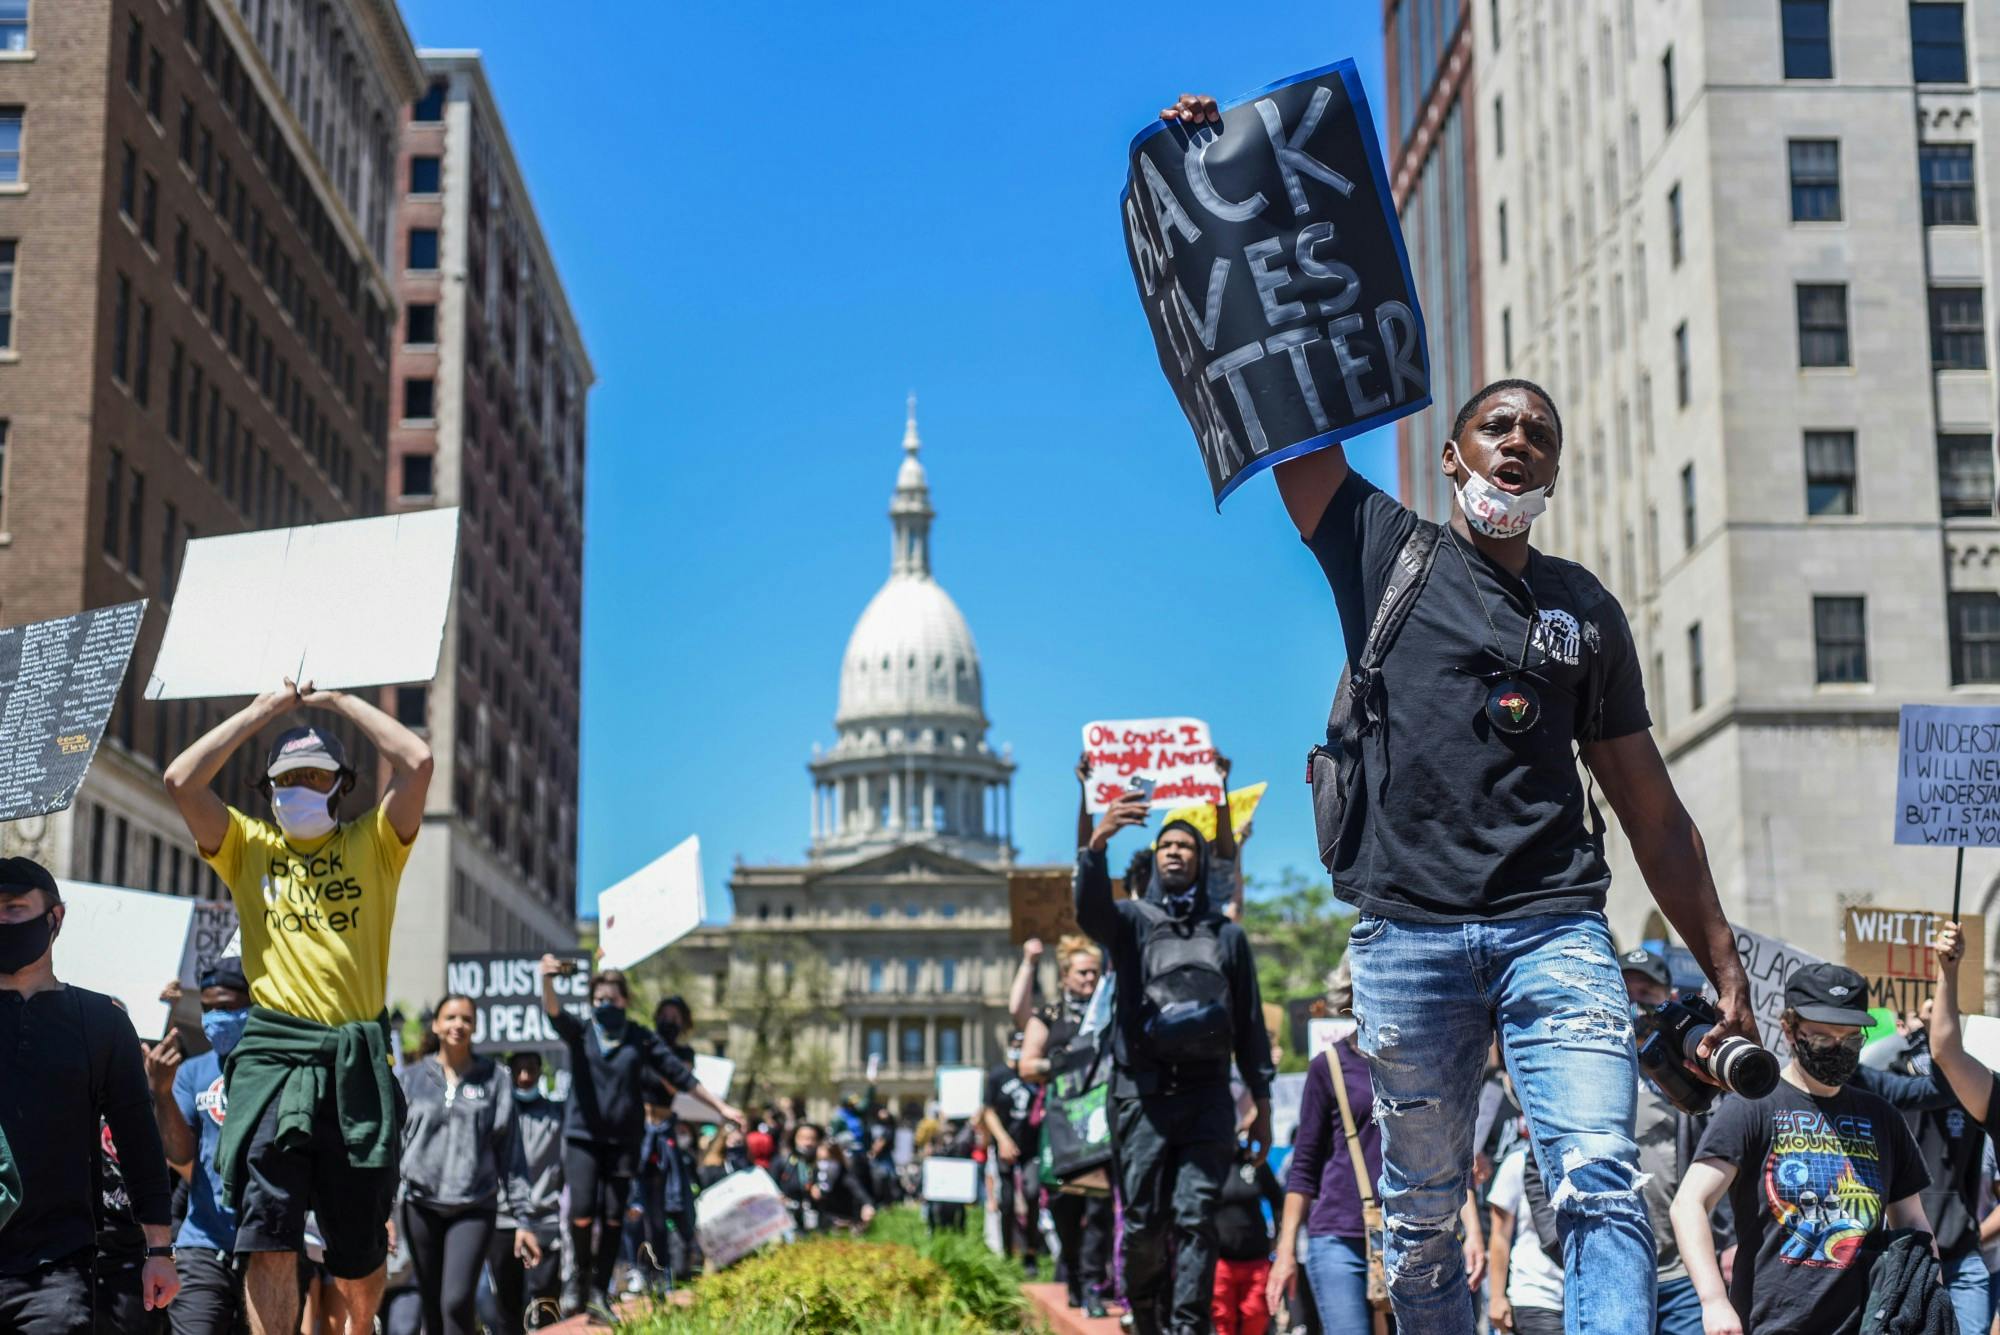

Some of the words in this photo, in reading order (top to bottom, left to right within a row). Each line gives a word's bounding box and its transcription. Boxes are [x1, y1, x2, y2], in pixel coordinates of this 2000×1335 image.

[1127, 86, 1356, 297] BLACK
[1159, 221, 1360, 377] LIVES
[1184, 300, 1426, 480] MATTER
[1179, 725, 1199, 746] I
[1915, 719, 2000, 754] UNDERST
[1916, 755, 1965, 781] WILL
[1905, 804, 1941, 825] BUT
[1922, 827, 1969, 843] WITH
[1975, 826, 2000, 845] YO
[288, 877, 362, 905] lives
[264, 906, 360, 932] matter
[1852, 910, 1942, 947] WHITE
[1736, 934, 1805, 987] BLAC
[447, 961, 484, 999] NO
[1863, 976, 1938, 1020] MATTE
[1774, 1110, 1874, 1143] SPACE
[1774, 1134, 1879, 1160] MOUNTAIN
